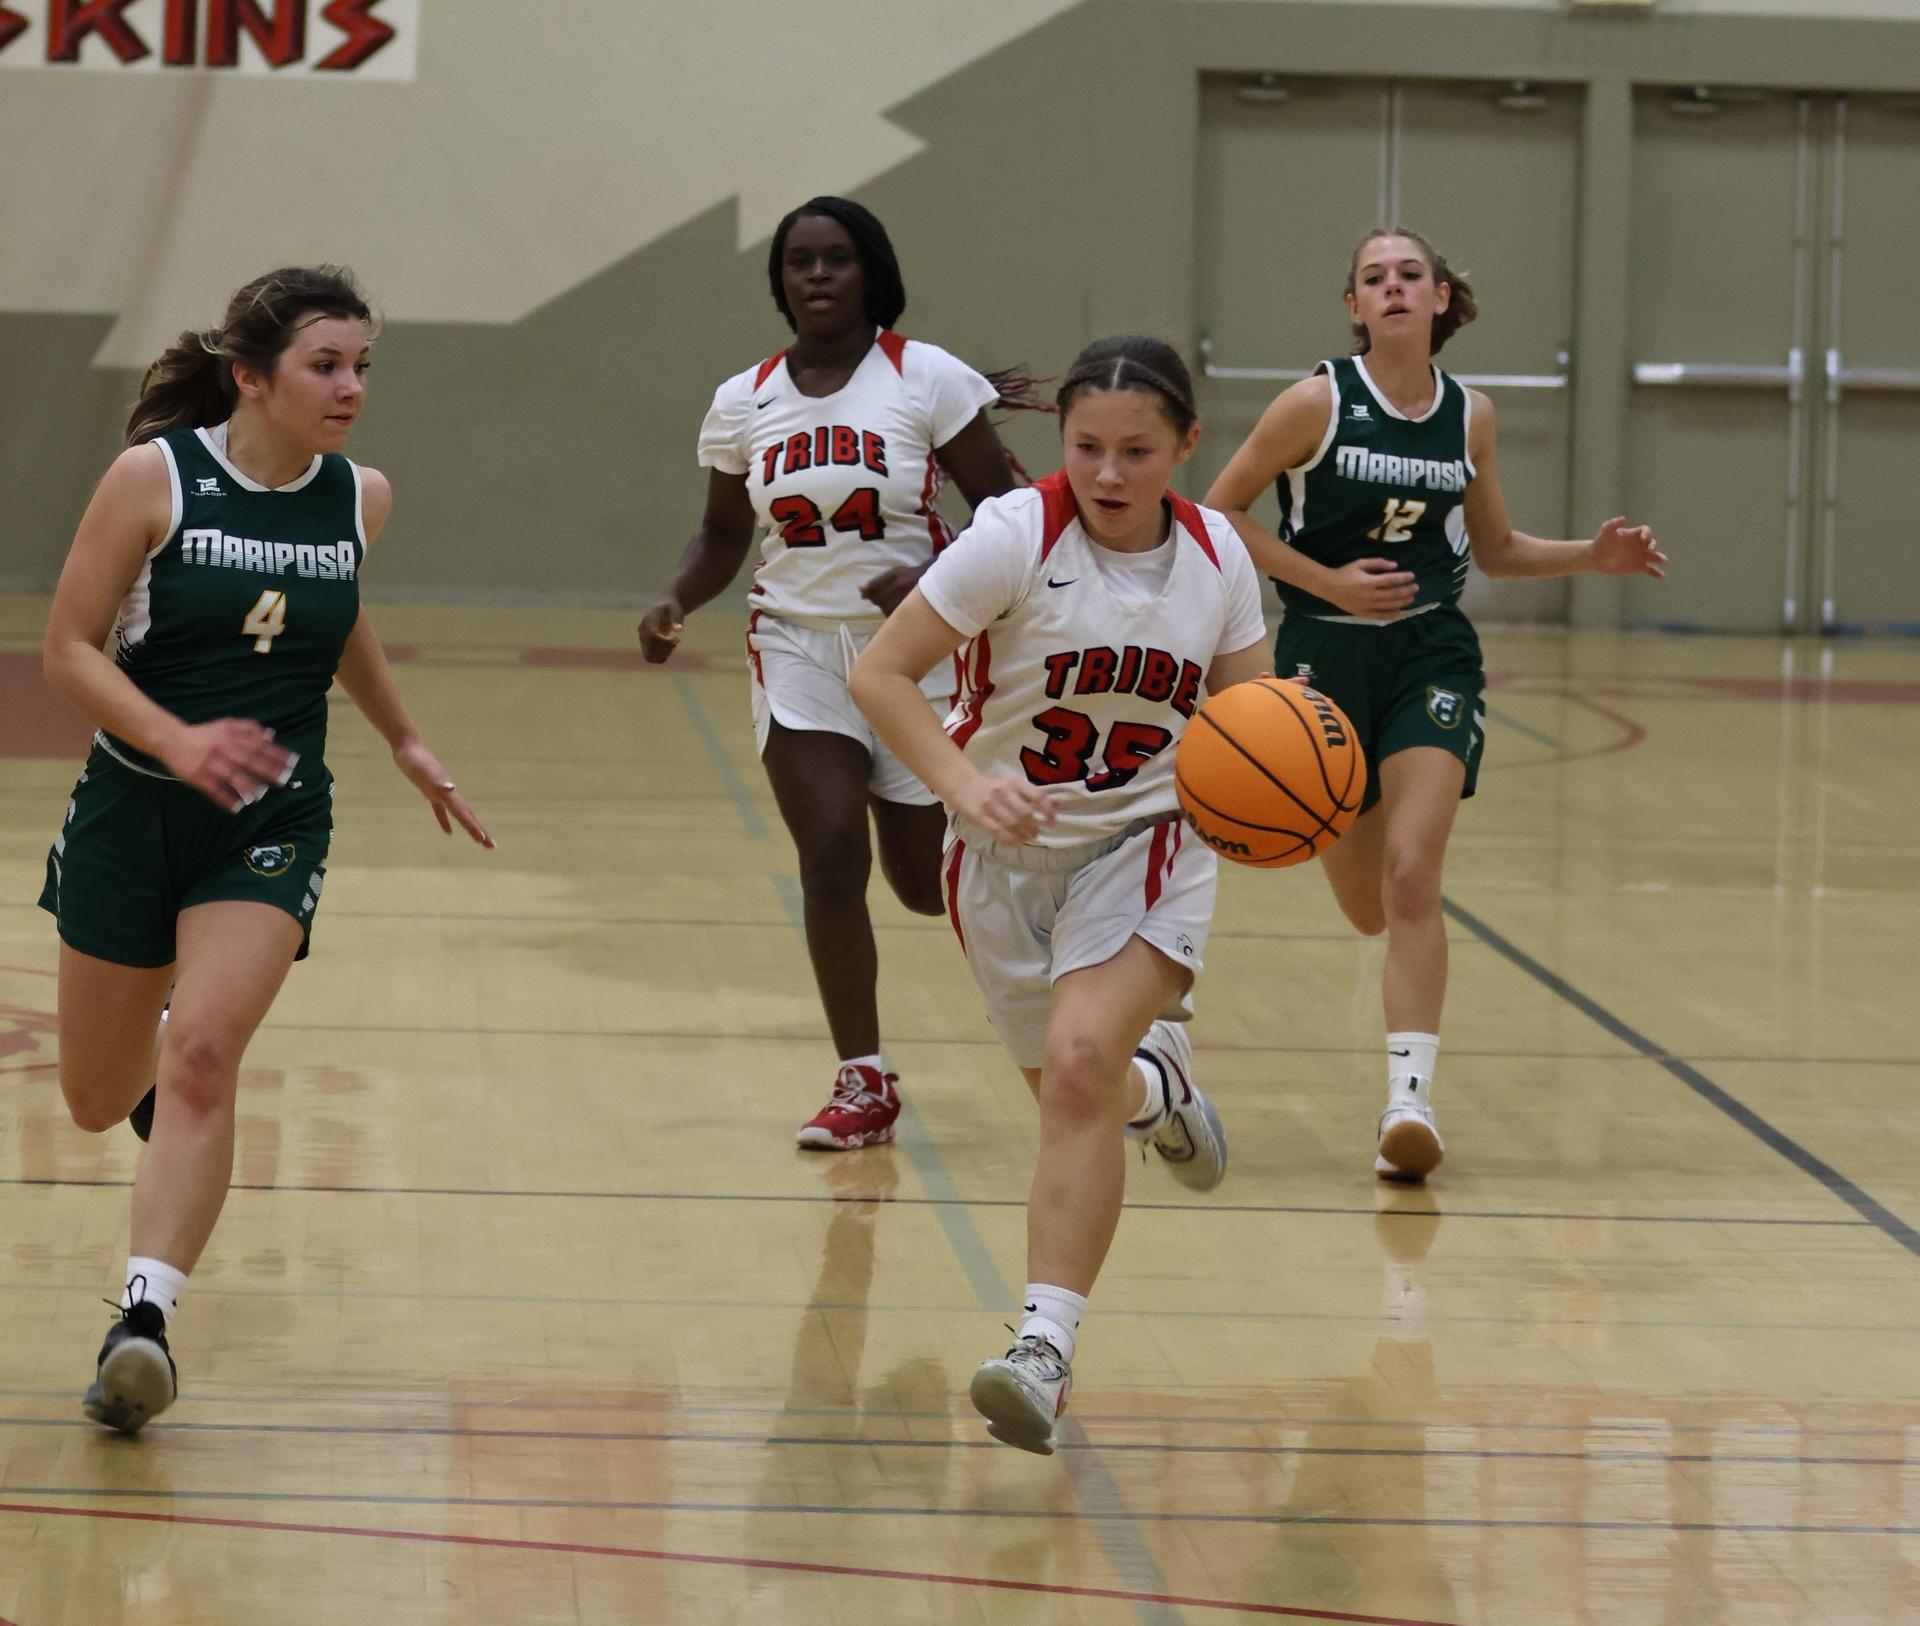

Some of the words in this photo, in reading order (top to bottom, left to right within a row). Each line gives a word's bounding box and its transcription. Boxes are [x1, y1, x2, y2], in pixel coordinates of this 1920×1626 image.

[0, 0, 397, 71] KINS
[761, 425, 889, 486] TRIBE
[1336, 445, 1467, 493] MARIPOSA
[769, 487, 887, 548] 24
[1366, 497, 1427, 543] 12
[181, 528, 356, 581] MARIPOSA
[241, 589, 287, 655] 4
[1044, 645, 1202, 720] TRIBE
[1019, 705, 1174, 793] 35
